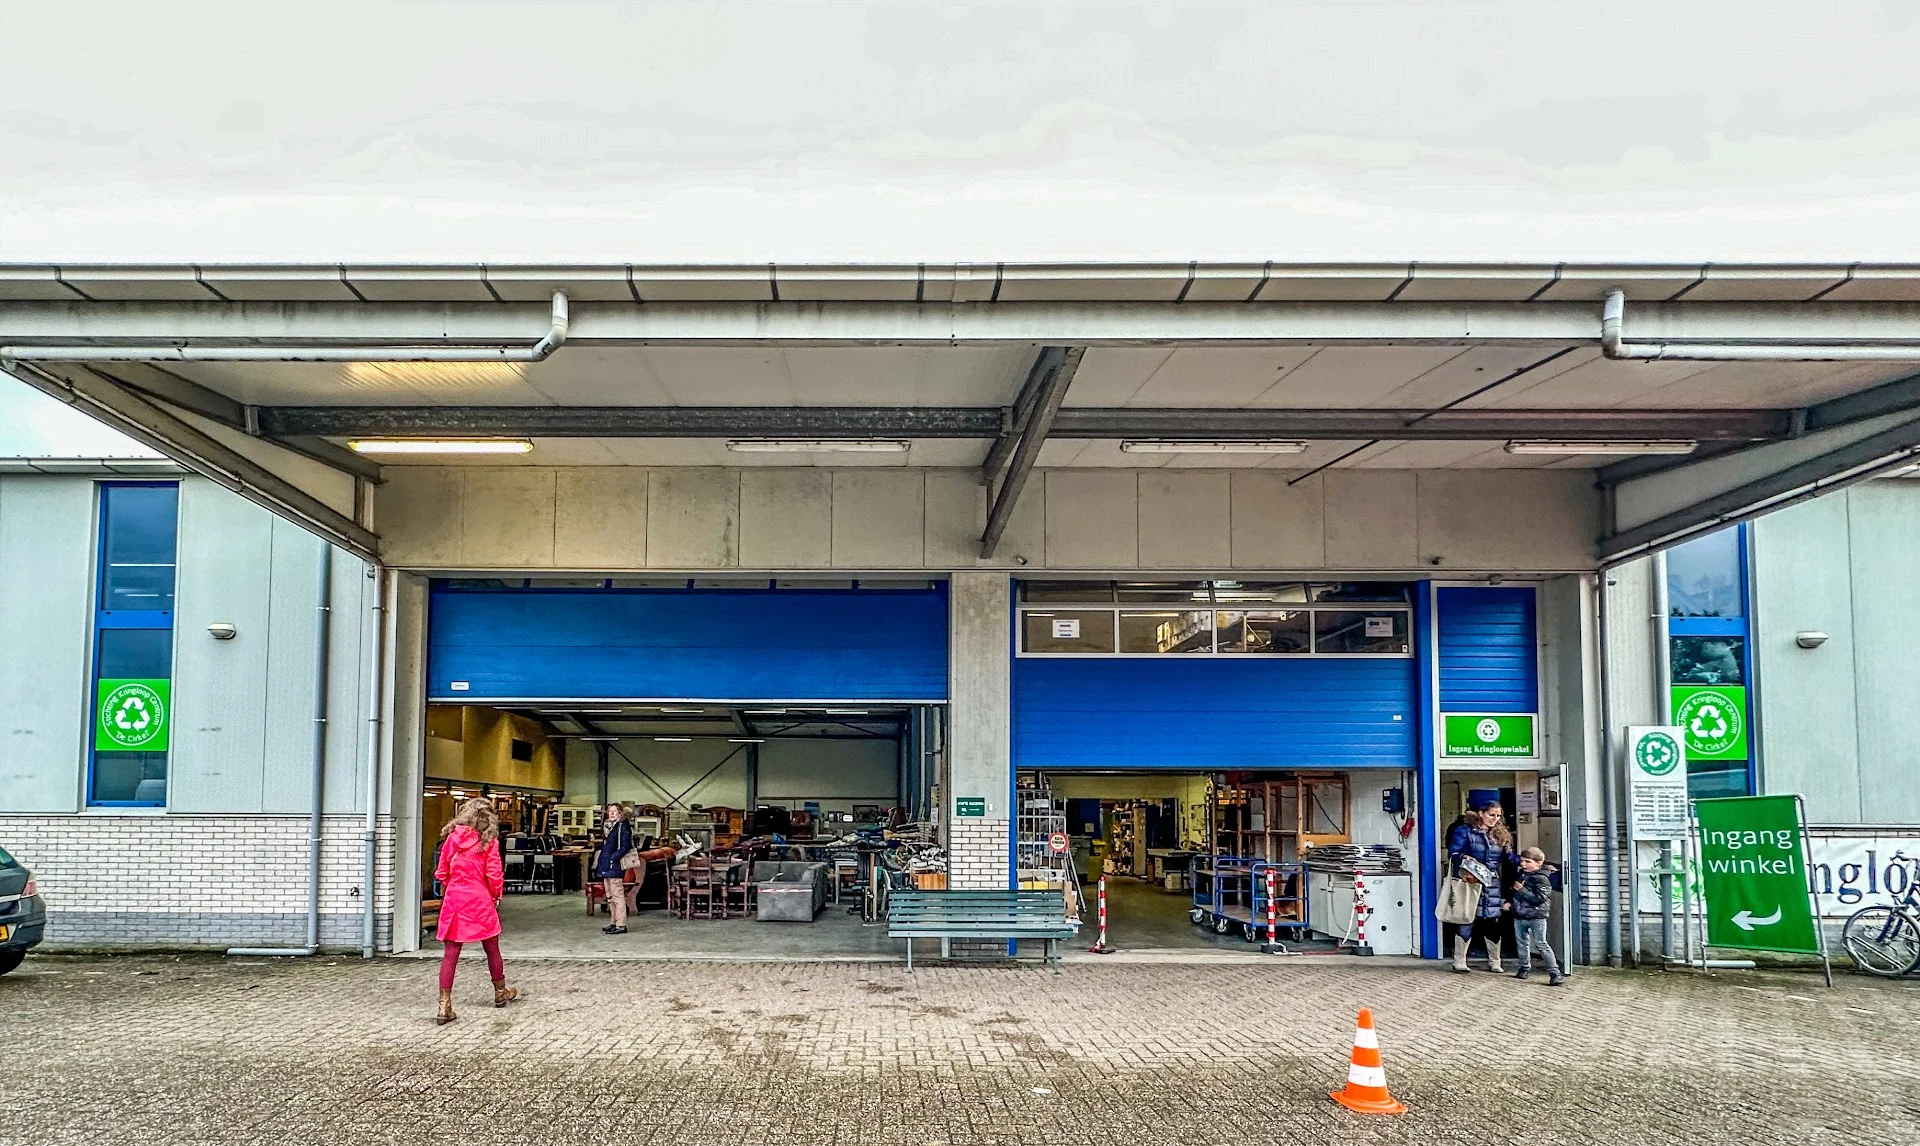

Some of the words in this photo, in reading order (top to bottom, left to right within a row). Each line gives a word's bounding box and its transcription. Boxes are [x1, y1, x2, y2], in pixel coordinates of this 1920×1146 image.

[105, 695, 118, 726] Stichting
[118, 687, 150, 698] Kringloop
[149, 696, 161, 726] Centrum
[1691, 695, 1727, 706] Kringloop
[1724, 704, 1738, 735] Centrum
[1448, 744, 1473, 754] Ingang
[1474, 744, 1530, 754] Kringloopwinkel
[1703, 828, 1793, 849] Ingang
[1708, 855, 1795, 875] winkel
